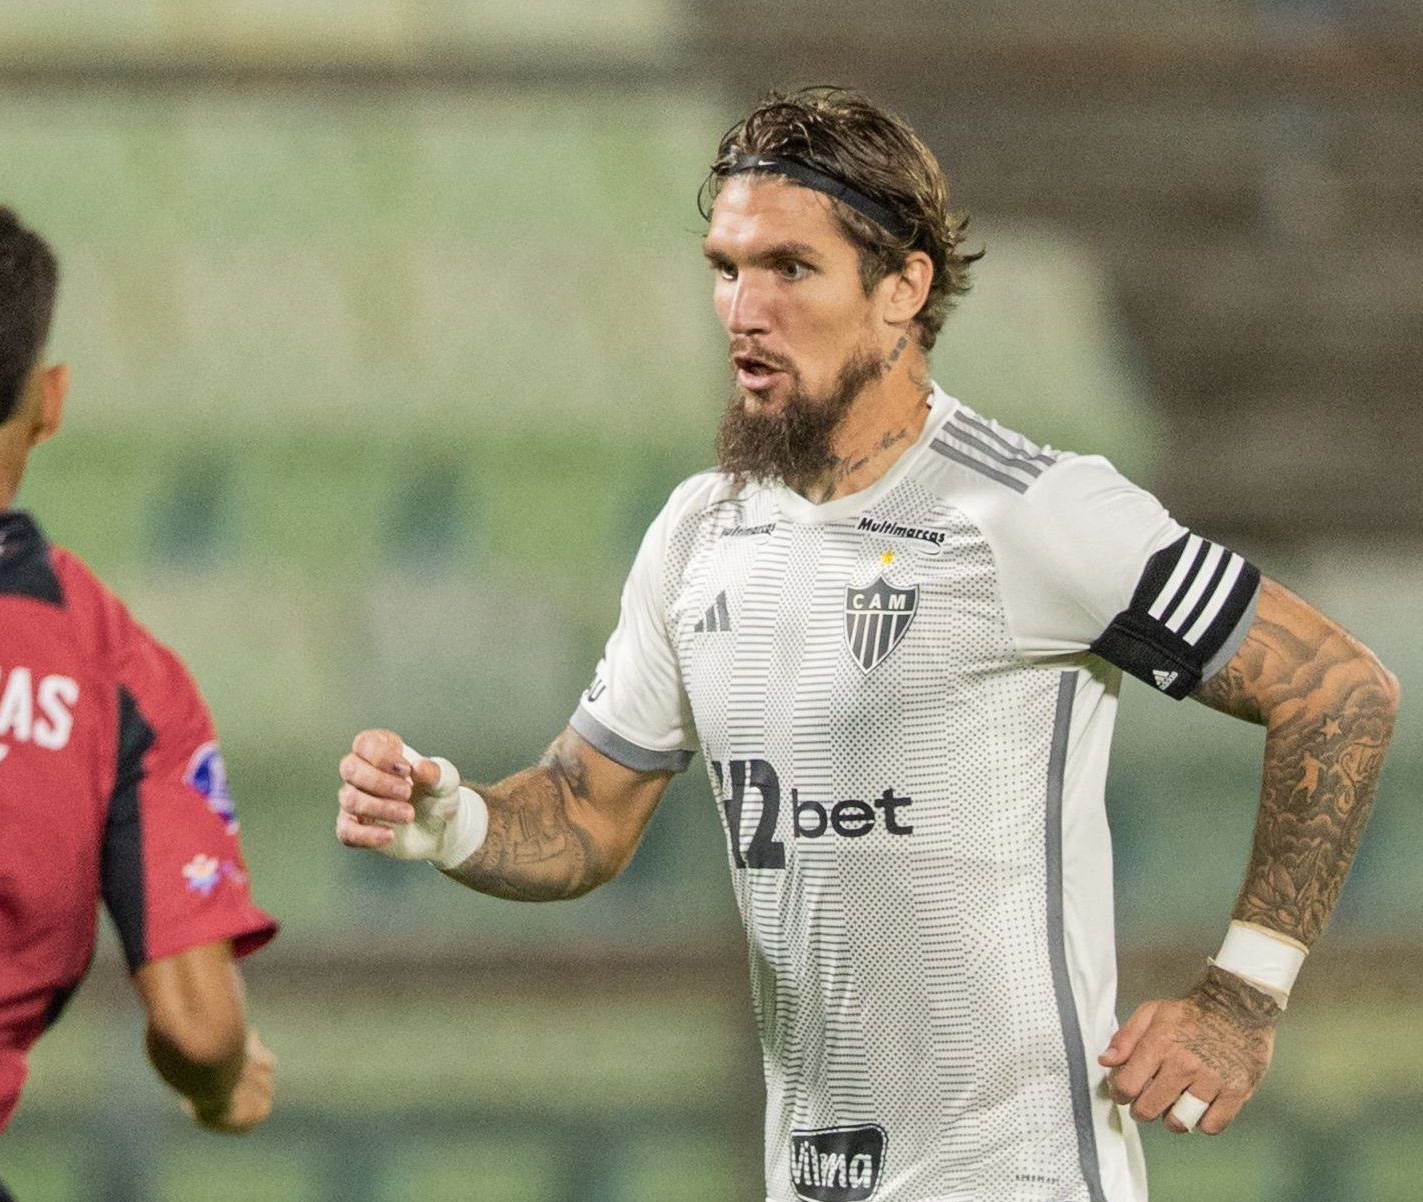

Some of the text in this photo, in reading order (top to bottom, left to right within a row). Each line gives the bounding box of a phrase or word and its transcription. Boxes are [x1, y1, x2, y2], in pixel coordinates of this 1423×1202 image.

[857, 517, 945, 543] Multimarcas
[852, 593, 906, 610] CAM
[791, 1140, 873, 1189] Vilma
